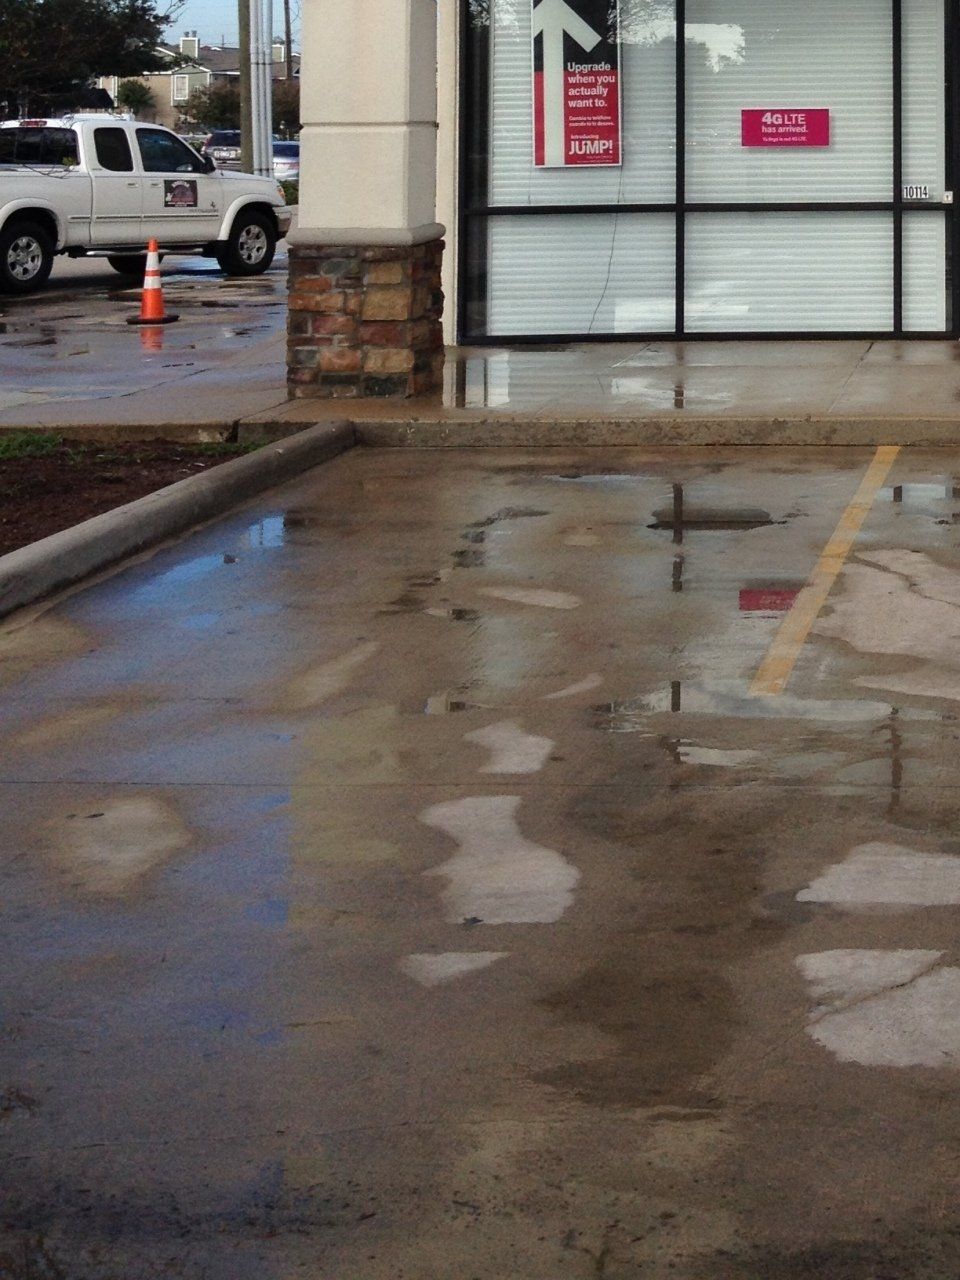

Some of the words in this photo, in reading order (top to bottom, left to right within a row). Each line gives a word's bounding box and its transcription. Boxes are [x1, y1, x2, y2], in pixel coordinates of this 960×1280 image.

[567, 61, 611, 74] Upgrade
[567, 74, 595, 84] when
[596, 75, 615, 85] you
[568, 85, 609, 97] actually
[568, 99, 593, 108] want
[594, 98, 608, 108] to.
[761, 111, 783, 125] 4G
[784, 113, 806, 125] LTE
[761, 125, 777, 133] has
[777, 125, 808, 133] arrived.
[568, 139, 613, 155] JUMP!
[905, 186, 928, 198] 10114
